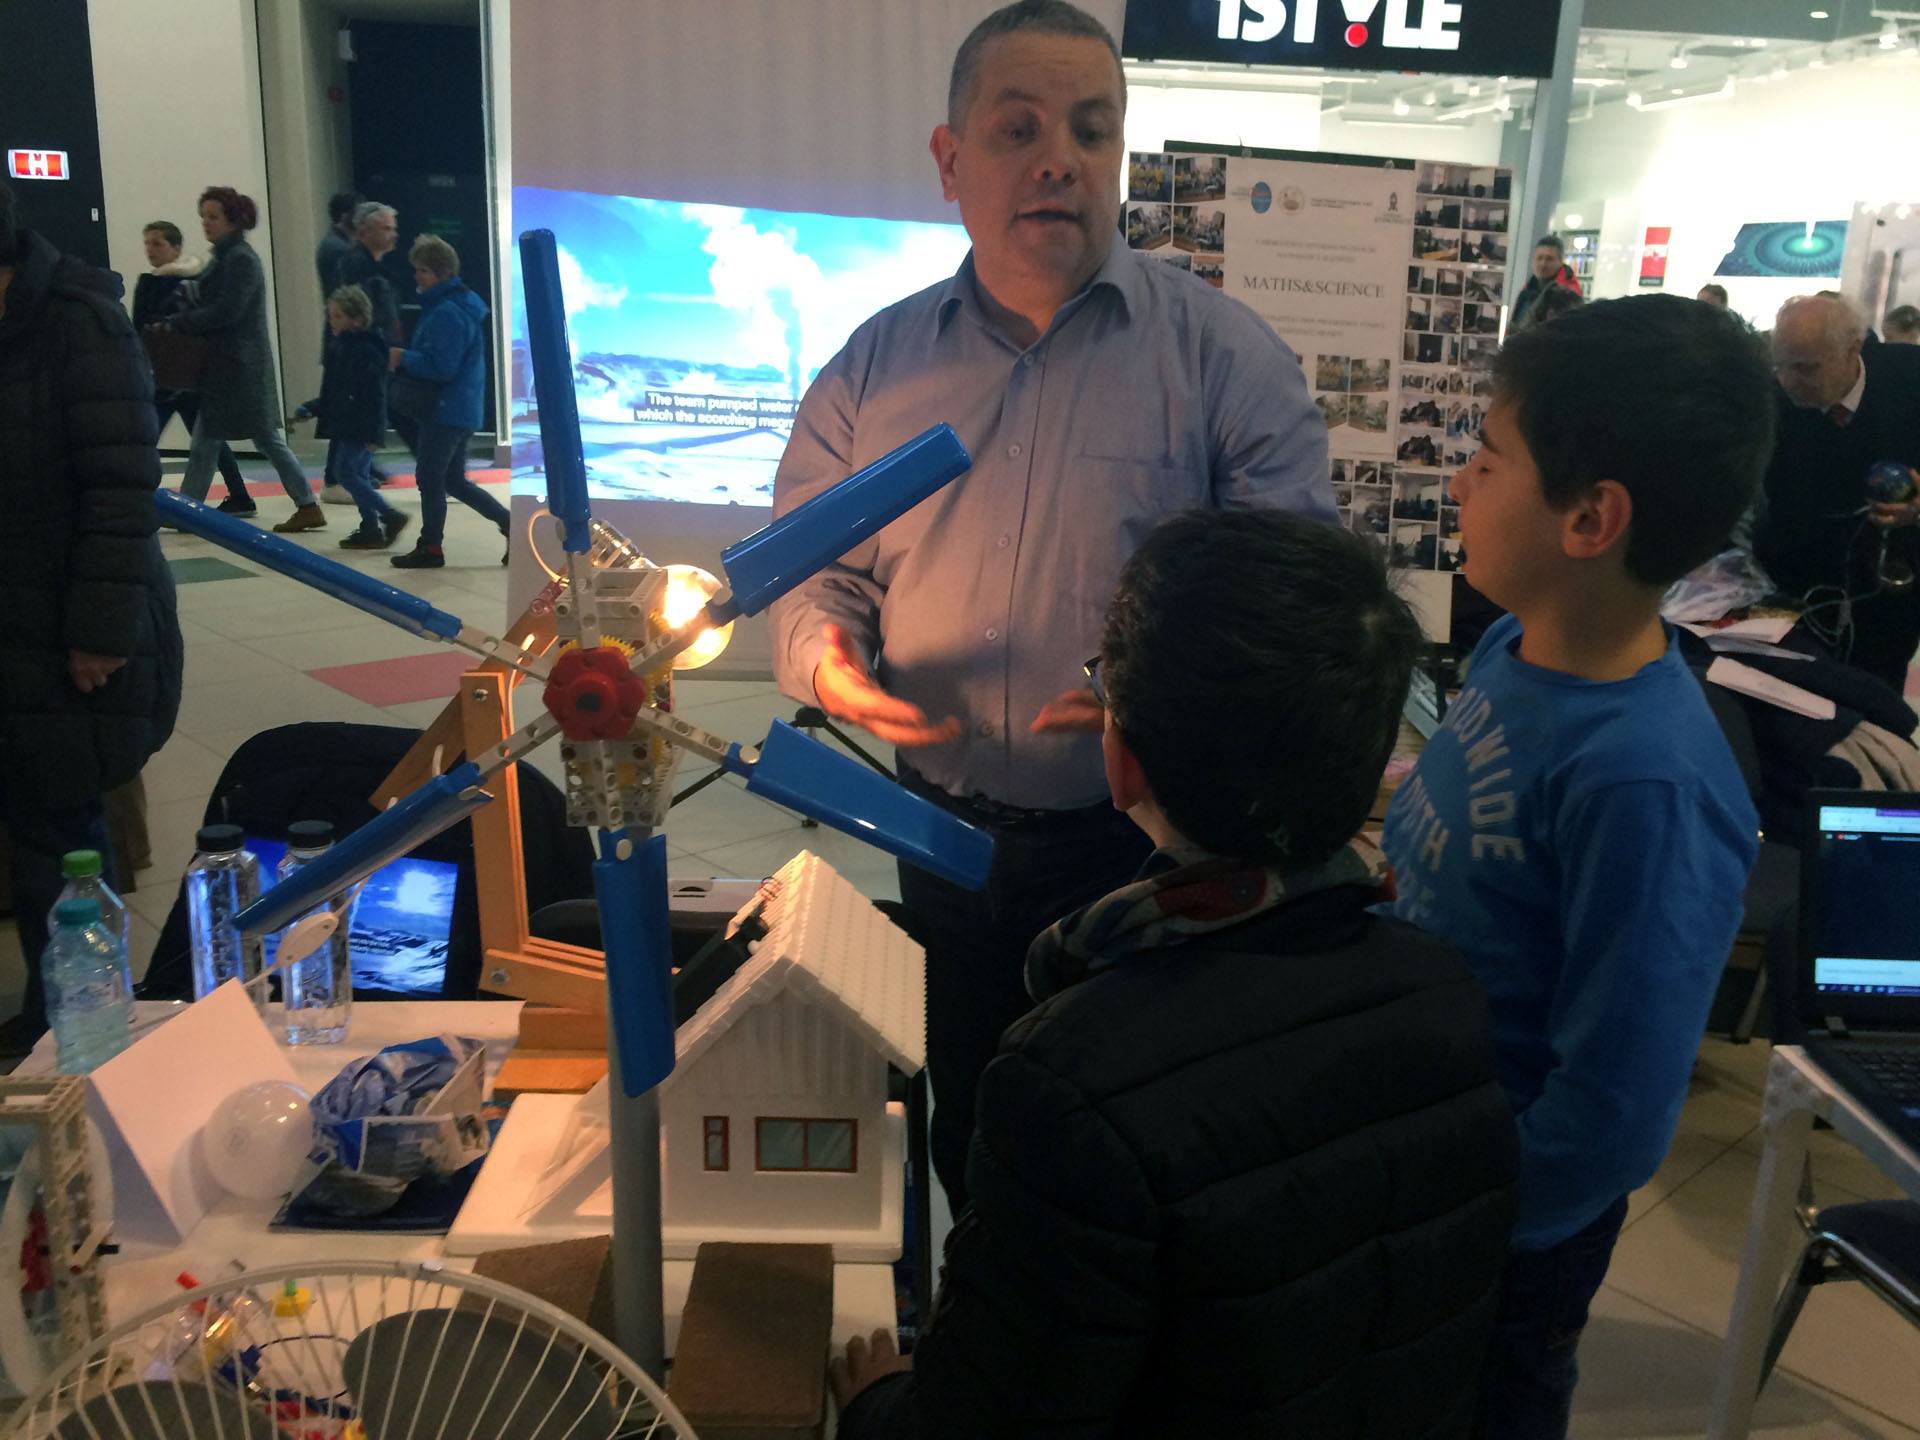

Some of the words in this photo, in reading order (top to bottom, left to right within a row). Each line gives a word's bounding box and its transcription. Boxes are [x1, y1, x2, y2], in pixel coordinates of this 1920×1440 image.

[1243, 275, 1386, 298] MATHS&SCIENCE
[648, 392, 673, 406] The
[674, 395, 706, 408] team
[707, 398, 758, 413] pumped
[758, 401, 794, 413] water
[635, 408, 673, 421] which
[675, 410, 696, 423] the
[697, 413, 757, 428] scorching
[758, 416, 794, 430] magm
